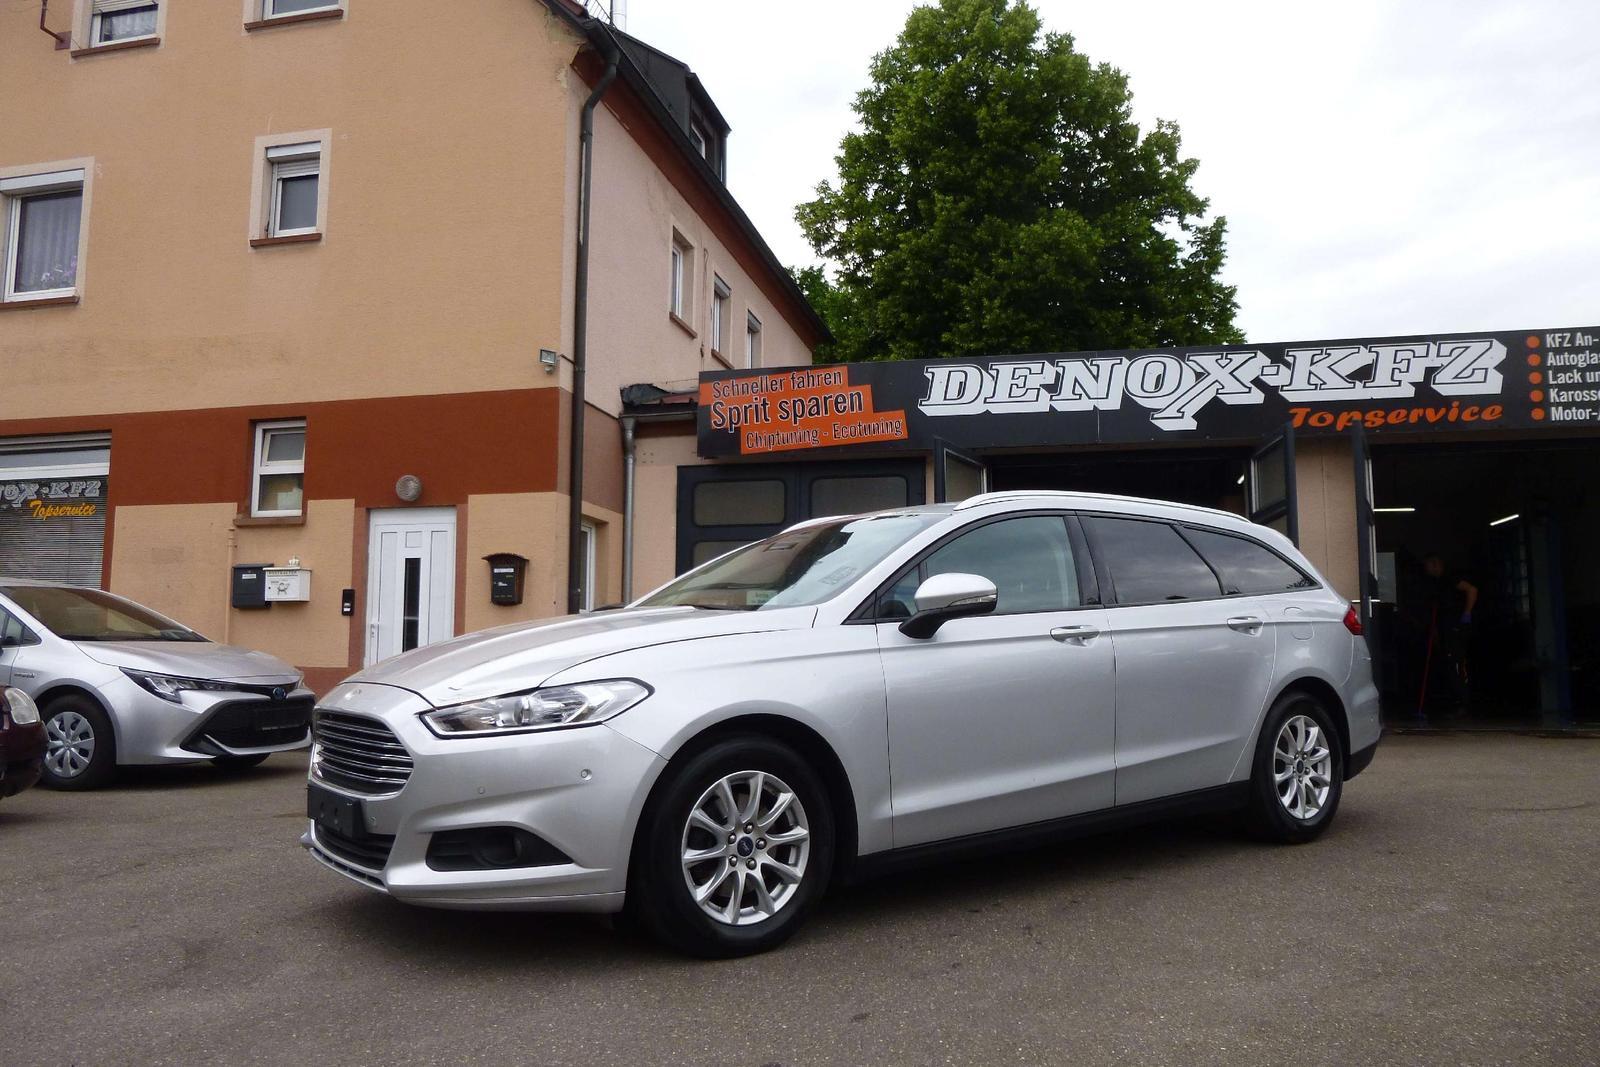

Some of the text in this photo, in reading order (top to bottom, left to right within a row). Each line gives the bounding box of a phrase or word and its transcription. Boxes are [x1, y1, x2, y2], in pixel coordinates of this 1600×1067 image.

[1545, 332, 1599, 348] KFZ An-
[712, 370, 842, 399] Schneller fahren
[918, 338, 1507, 431] DENOX-KFZ
[1548, 369, 1583, 385] Lack
[1549, 387, 1600, 403] Kaross
[711, 390, 863, 433] Sprit sparen
[1289, 401, 1503, 431] Topservice
[1551, 406, 1600, 421] Motor-
[746, 427, 820, 451] Chiptuning
[832, 418, 904, 440] Ecotuning
[0, 480, 102, 508] OX-KFZ
[29, 499, 97, 521] Topservice
